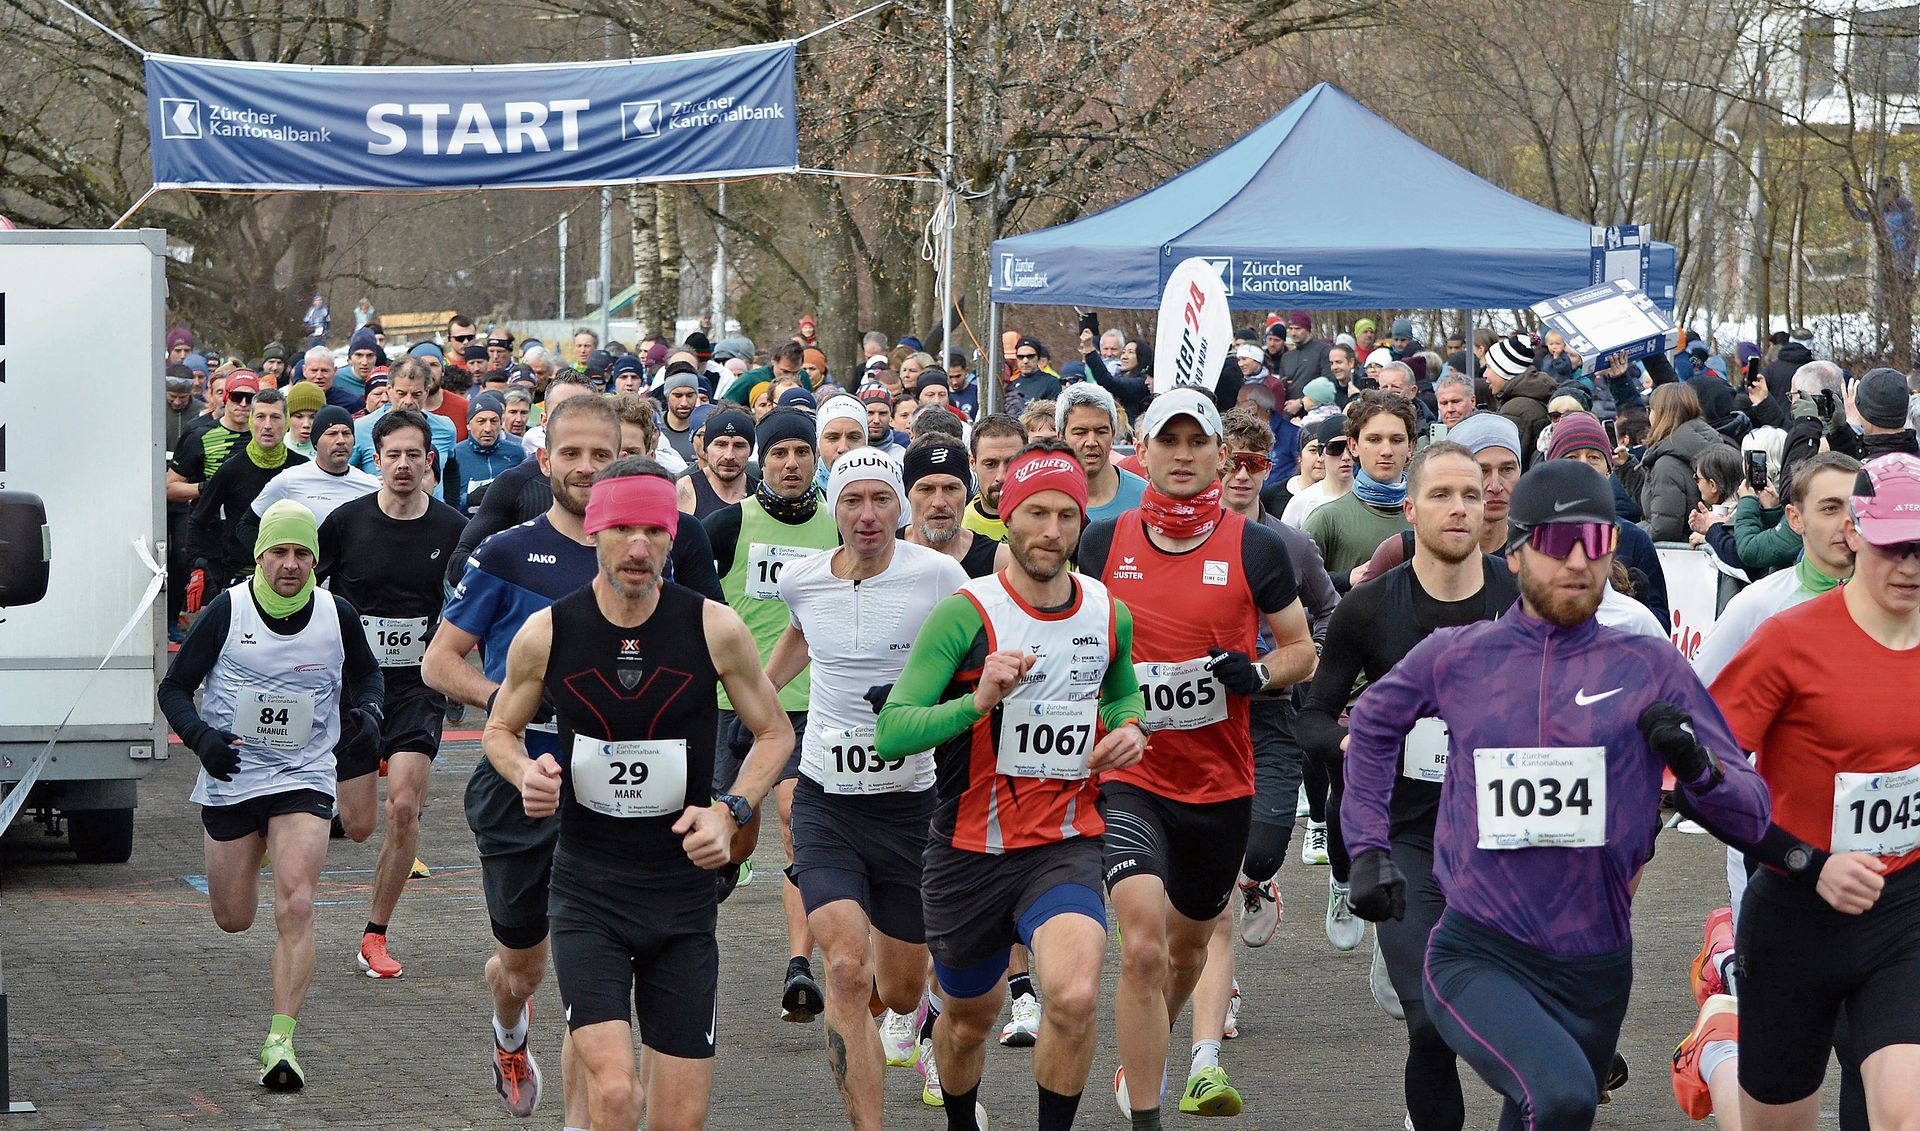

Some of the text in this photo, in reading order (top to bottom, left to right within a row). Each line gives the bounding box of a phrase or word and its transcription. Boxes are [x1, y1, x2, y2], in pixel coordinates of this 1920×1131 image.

[209, 105, 277, 124] Zürcher
[668, 103, 785, 130] Kantonalbank
[670, 97, 736, 117] Zürcher
[210, 121, 331, 142] Kantonalbank
[366, 99, 590, 156] START
[1242, 261, 1303, 276] Zürcher
[1242, 277, 1352, 293] Kantonalbank
[838, 457, 902, 484] SUUNTO
[527, 552, 556, 564] JAKO
[377, 631, 412, 646] 166
[1072, 636, 1101, 647] OM24
[1139, 677, 1215, 711] 1065
[259, 707, 289, 726] 84
[256, 726, 288, 736] EMANUEL
[1015, 723, 1091, 756] 1067
[1521, 752, 1550, 760] Zürcher
[1521, 759, 1574, 767] Kantonalbank
[608, 761, 649, 786] 29
[614, 789, 642, 799] MARK
[1487, 777, 1593, 818] 1034
